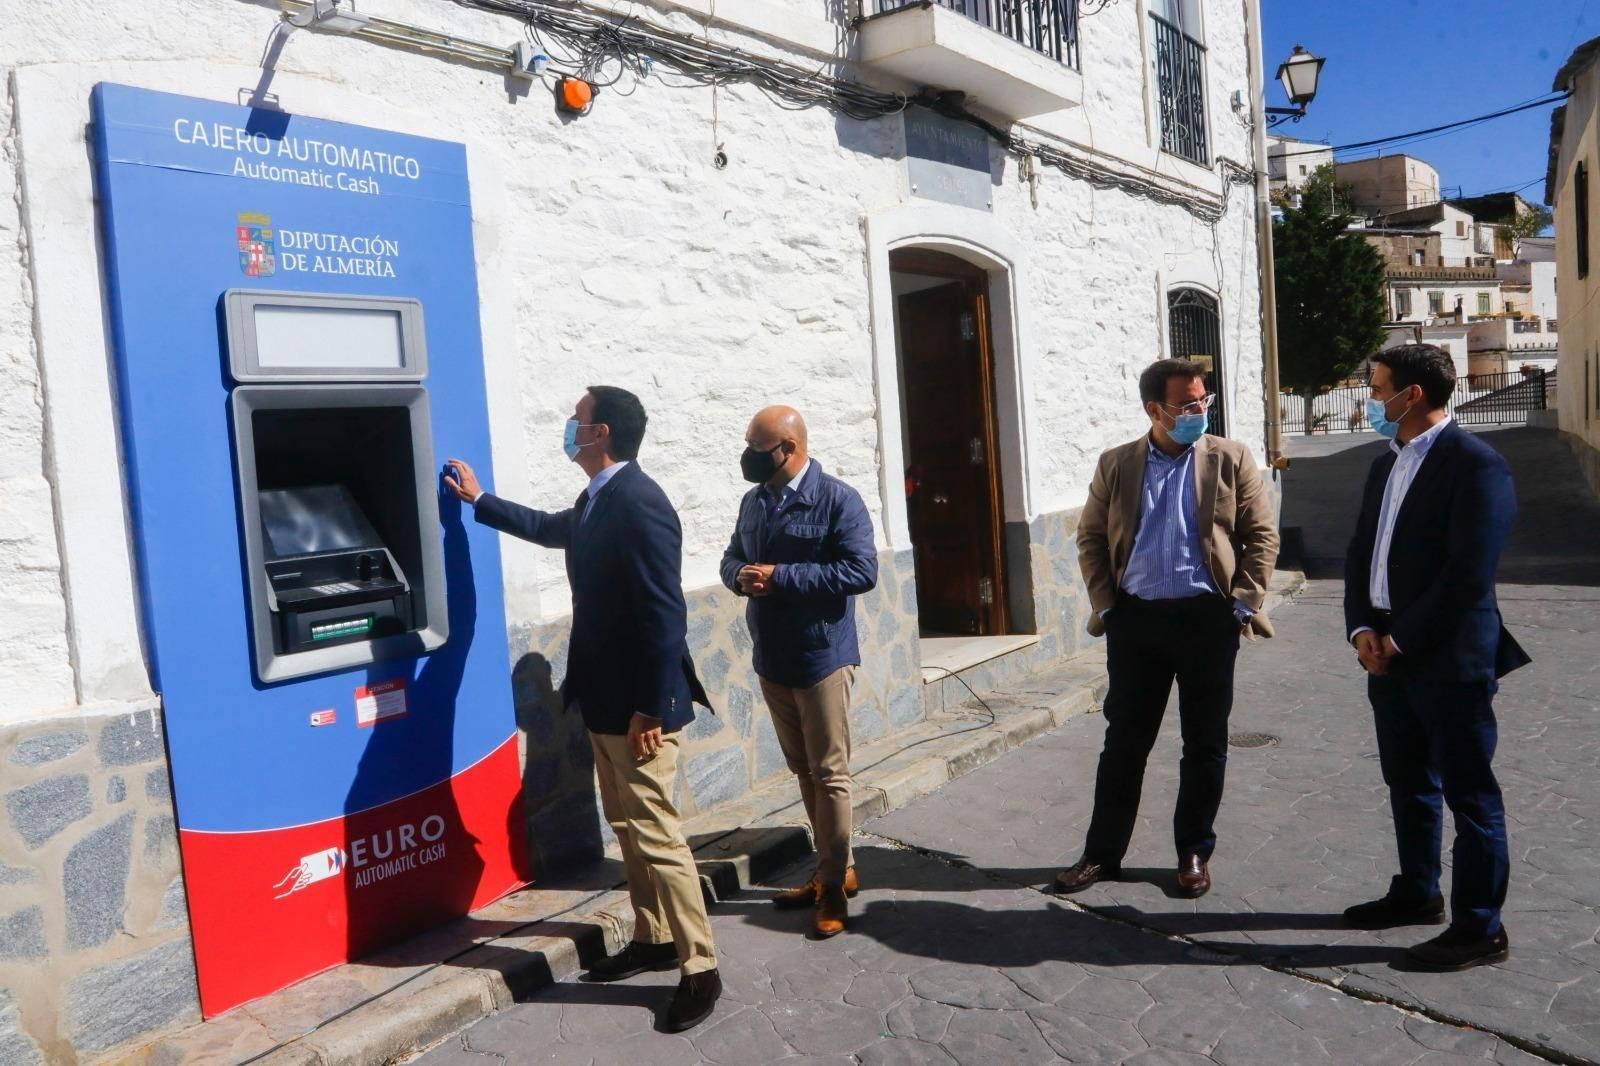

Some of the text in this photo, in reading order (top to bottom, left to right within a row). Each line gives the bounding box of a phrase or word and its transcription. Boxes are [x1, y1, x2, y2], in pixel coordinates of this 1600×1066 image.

[174, 118, 420, 180] CAJERO AUTOMATICO
[233, 157, 379, 195] Automatic Cash
[279, 229, 399, 257] DIPUTACIÓN
[281, 252, 396, 278] DE ALMERÍA
[351, 814, 445, 868] EURO
[355, 842, 446, 889] AUTOMATIC CASH
